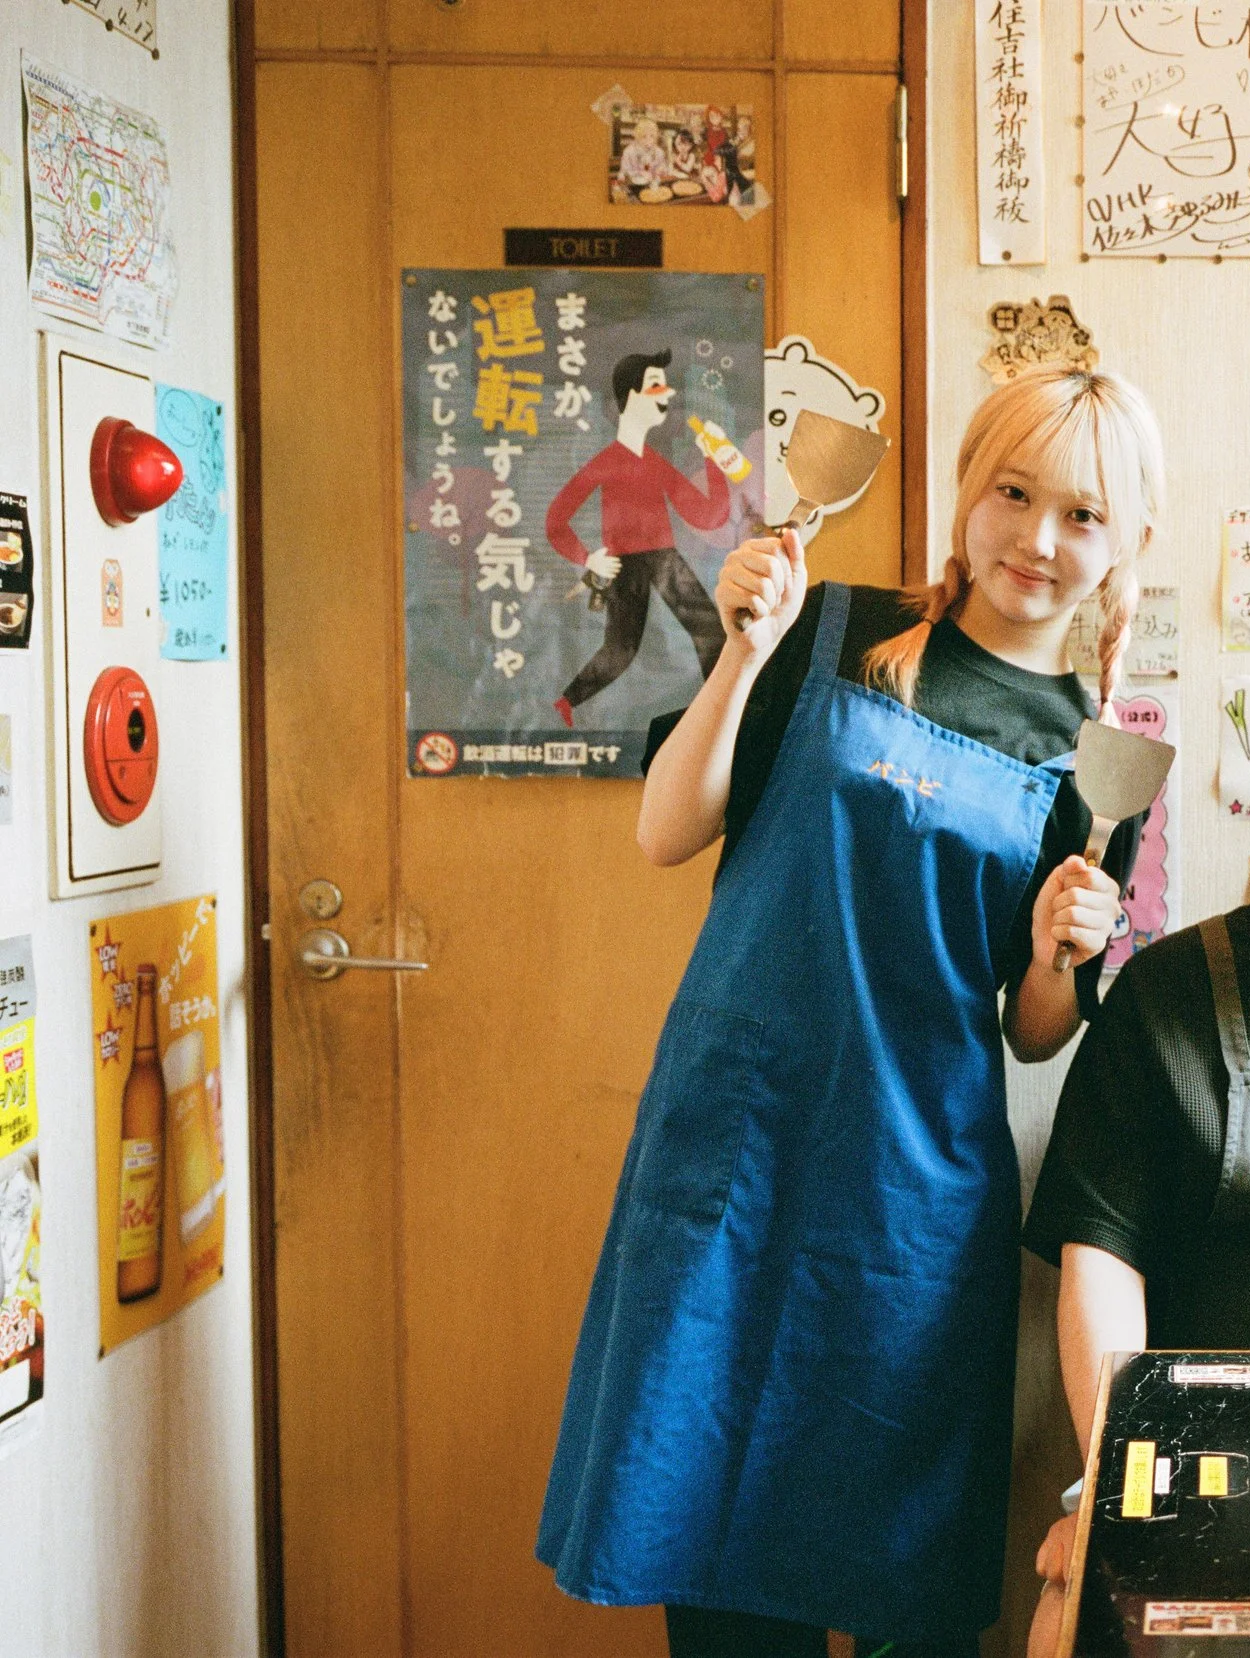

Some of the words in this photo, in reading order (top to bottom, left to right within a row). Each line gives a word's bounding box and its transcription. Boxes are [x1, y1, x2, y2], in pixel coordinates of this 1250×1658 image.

[551, 237, 618, 259] TOILET
[427, 290, 462, 545] ないでしょうね。
[554, 292, 592, 431] まさか、
